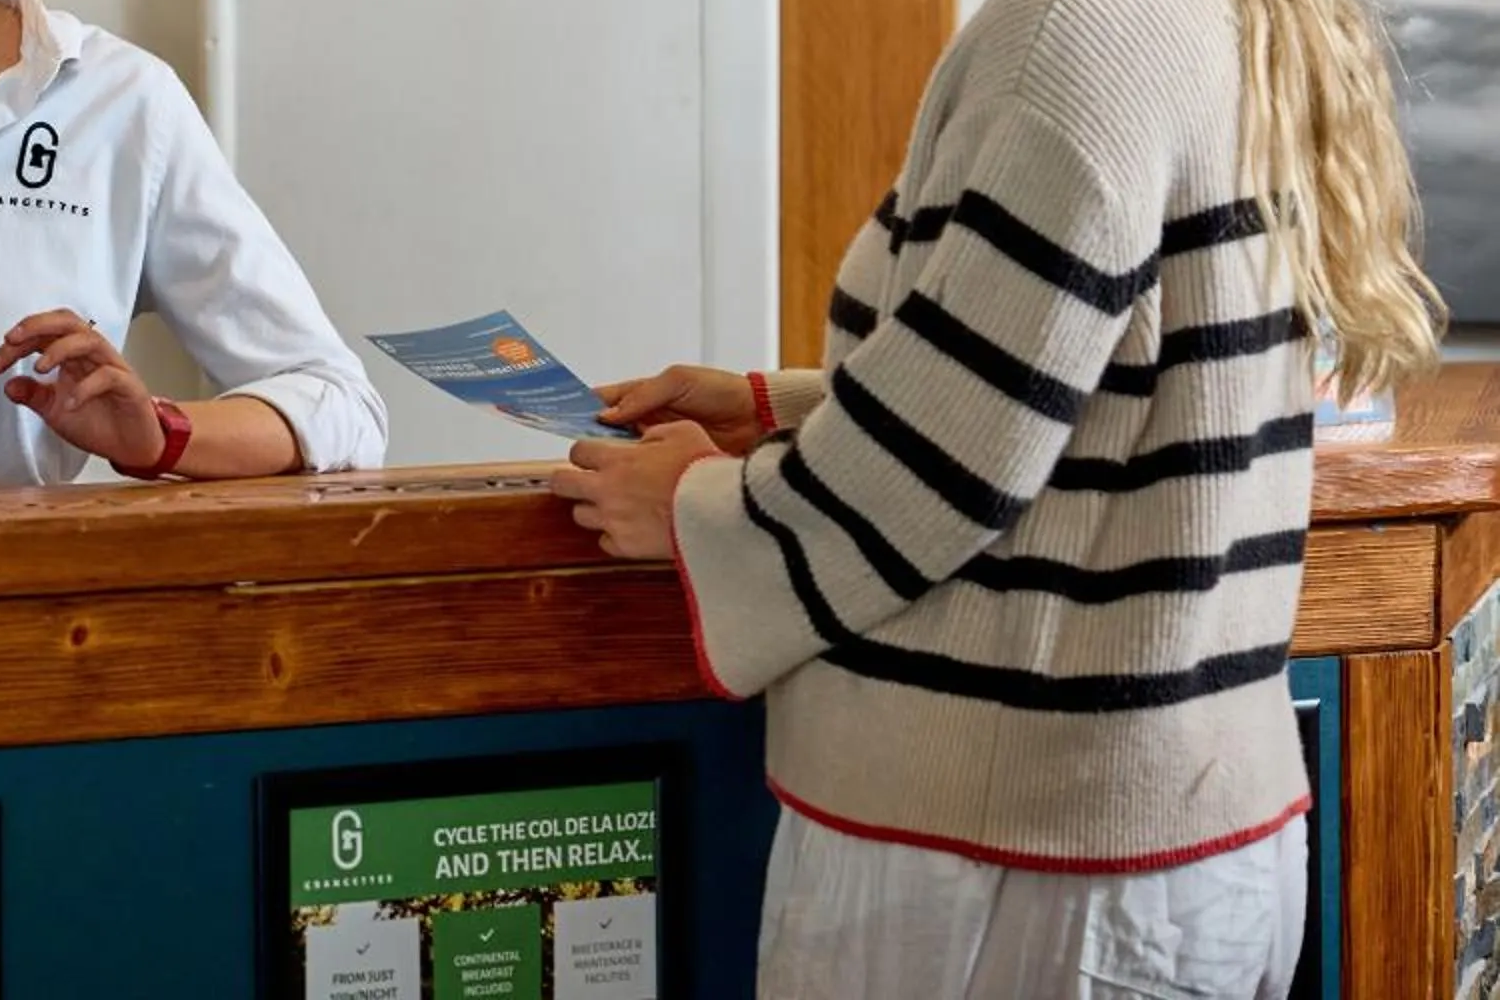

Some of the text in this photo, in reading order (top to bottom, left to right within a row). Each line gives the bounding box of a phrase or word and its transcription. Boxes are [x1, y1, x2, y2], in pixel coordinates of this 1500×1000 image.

[433, 824, 488, 847] CYCLE
[489, 821, 527, 842] THE
[528, 818, 564, 839] COL
[565, 816, 589, 836] DE
[591, 813, 613, 833] LA
[434, 853, 489, 880] AND
[498, 845, 563, 874] THEN
[332, 968, 396, 985] FROM JUST
